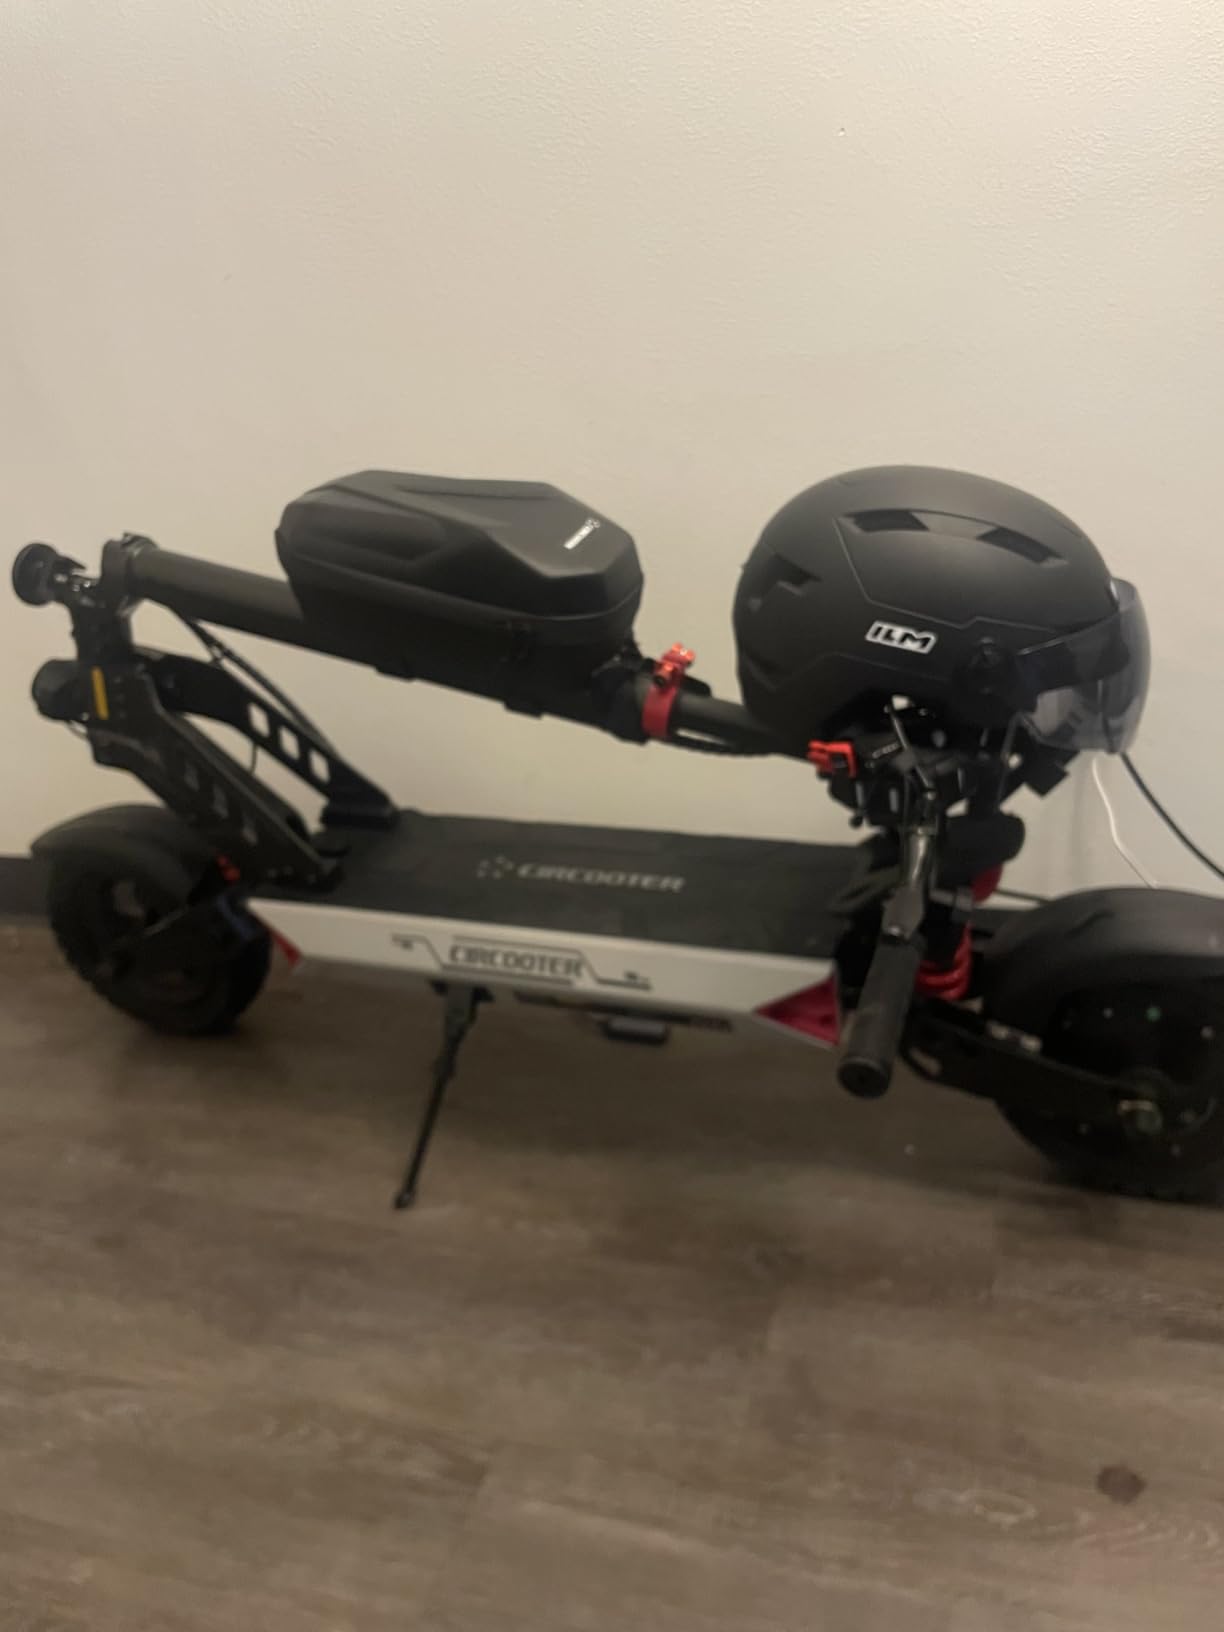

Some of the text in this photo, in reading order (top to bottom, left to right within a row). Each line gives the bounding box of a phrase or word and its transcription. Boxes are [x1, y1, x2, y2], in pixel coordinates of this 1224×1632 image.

[868, 622, 935, 652] ILM
[517, 863, 686, 892] CIRCOOTER
[450, 944, 582, 978] CIRCOOTER
